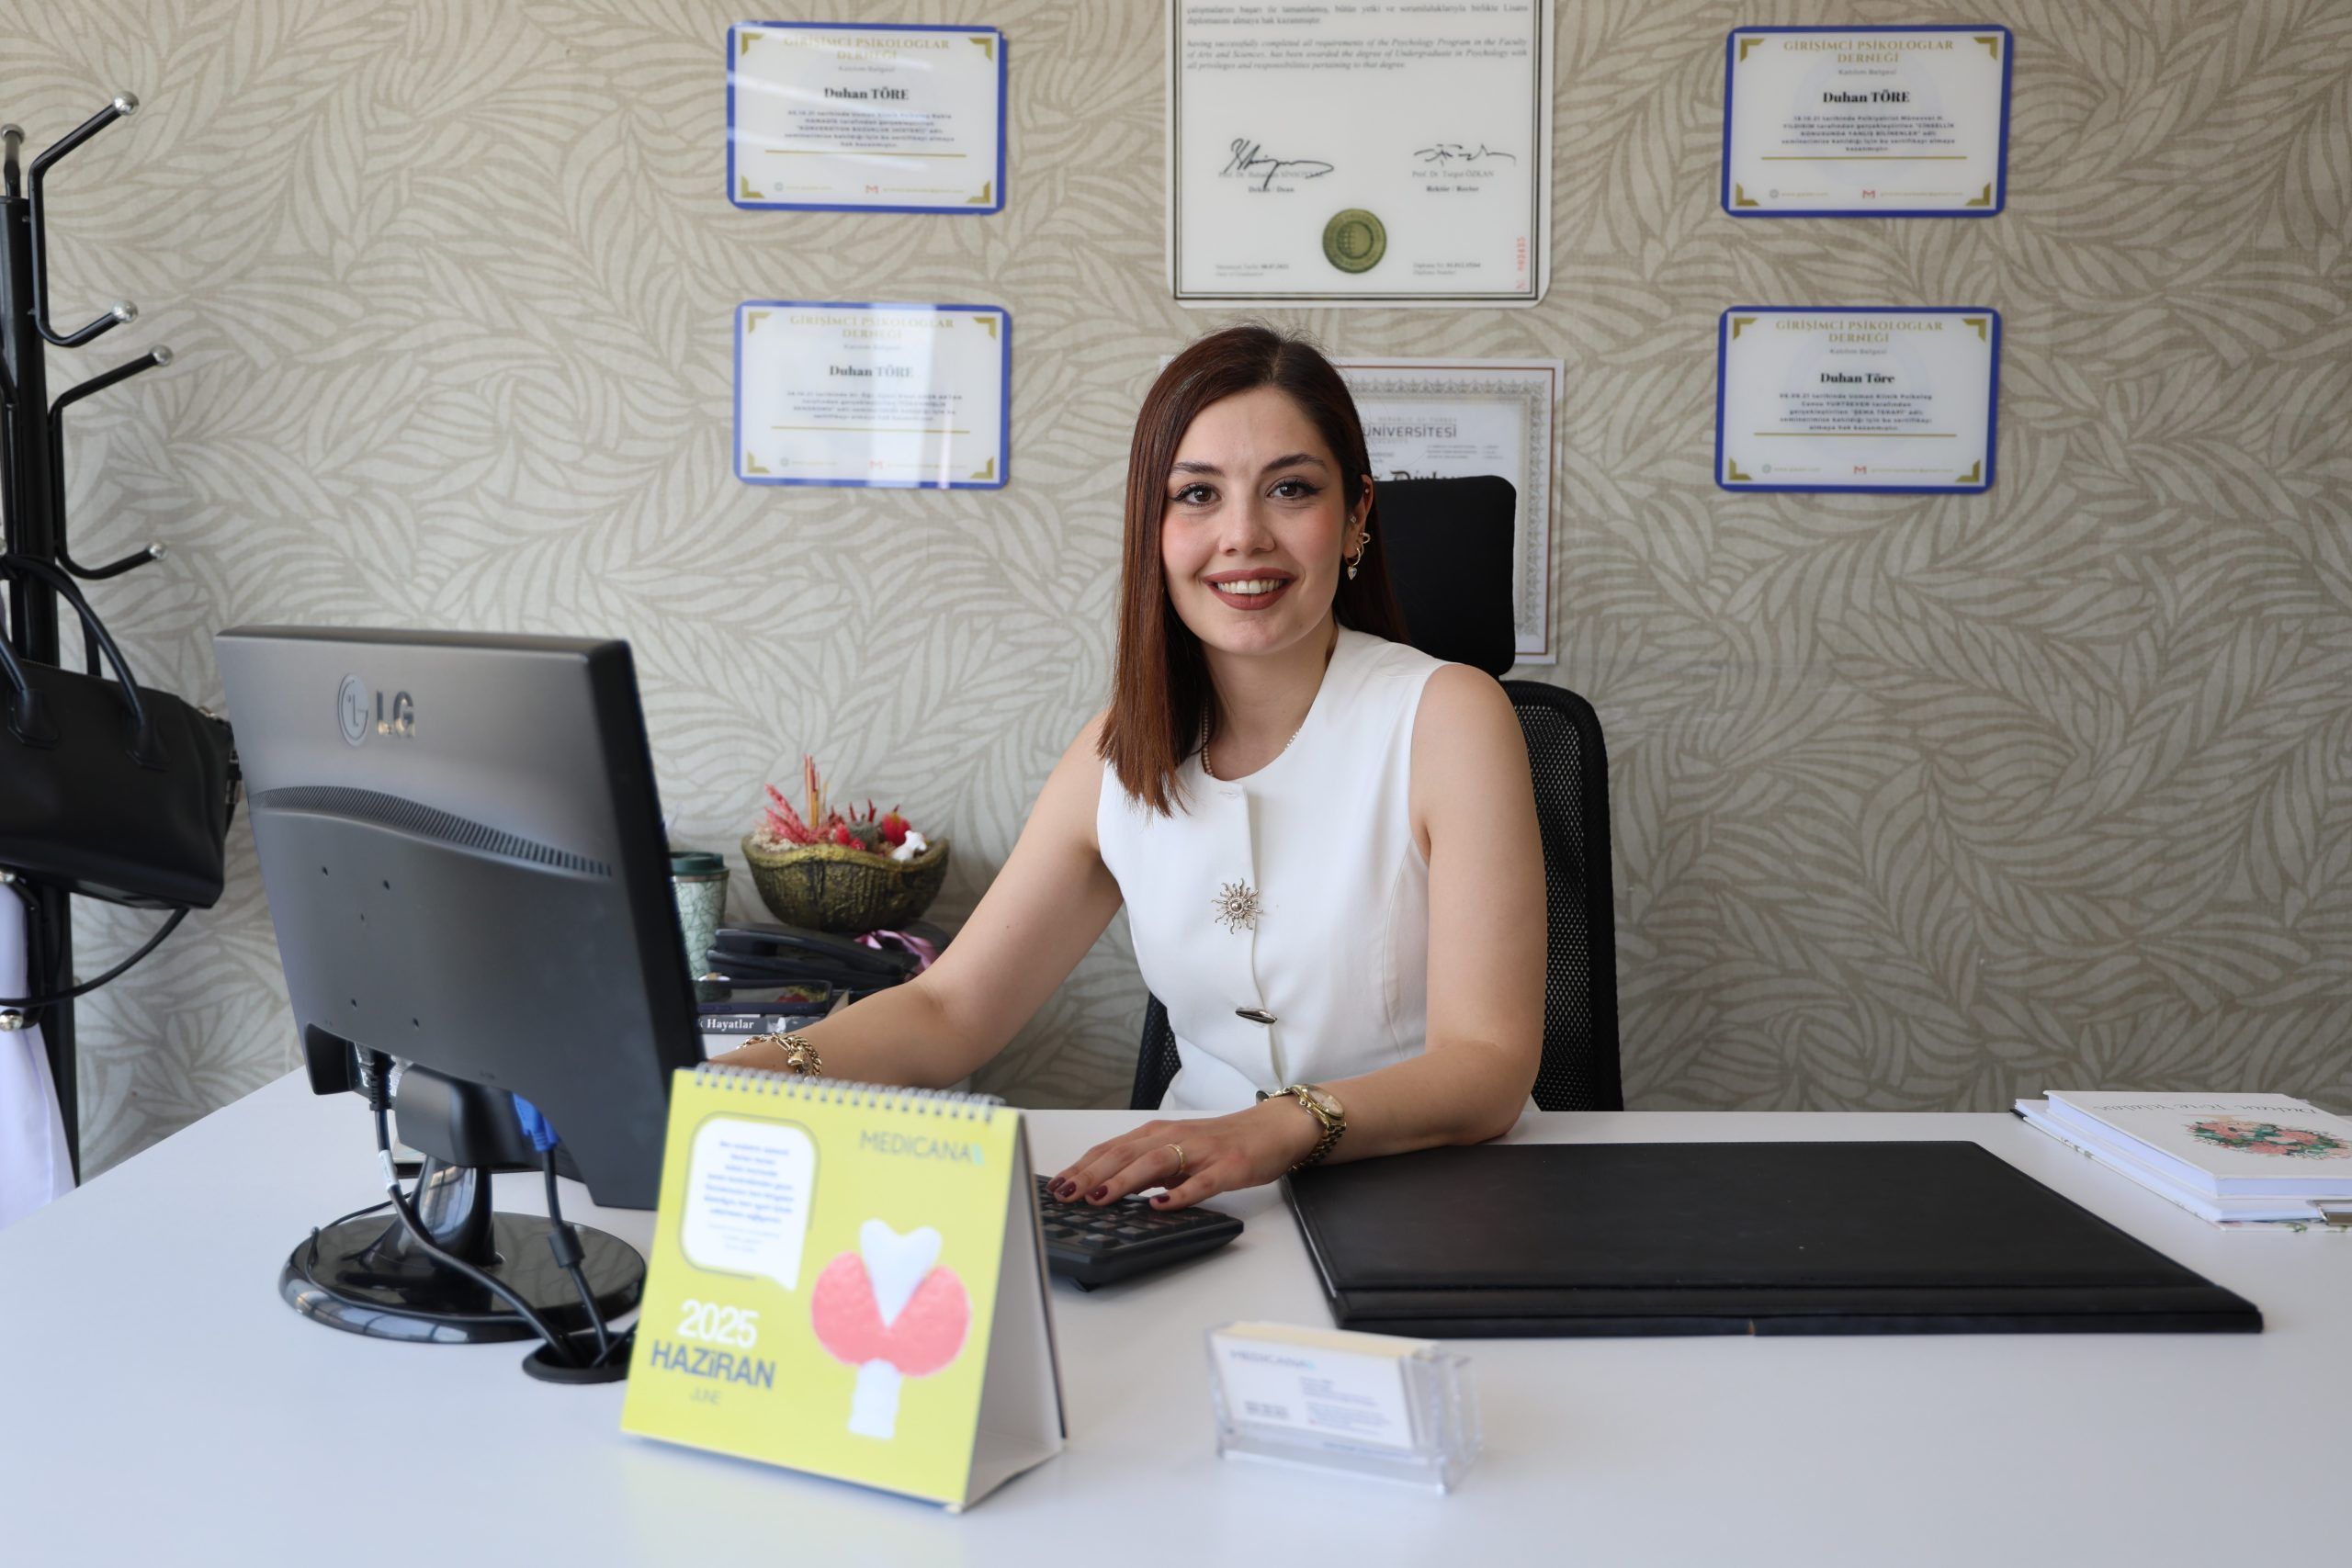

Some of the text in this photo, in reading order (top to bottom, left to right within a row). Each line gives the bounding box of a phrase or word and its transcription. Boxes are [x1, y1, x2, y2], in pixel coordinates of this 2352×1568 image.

[824, 86, 909, 101] Duhan TÖRE
[1823, 88, 1910, 104] Duhan TÖRE
[830, 364, 914, 378] Duhan TÖRE
[1820, 371, 1895, 384] Duhan Töre
[1363, 423, 1457, 438] ÜNİVERSİTESİ
[376, 690, 415, 738] LG
[707, 1018, 754, 1031] Hayatlar
[860, 1130, 972, 1164] MEDICANA
[677, 1298, 760, 1348] 2025
